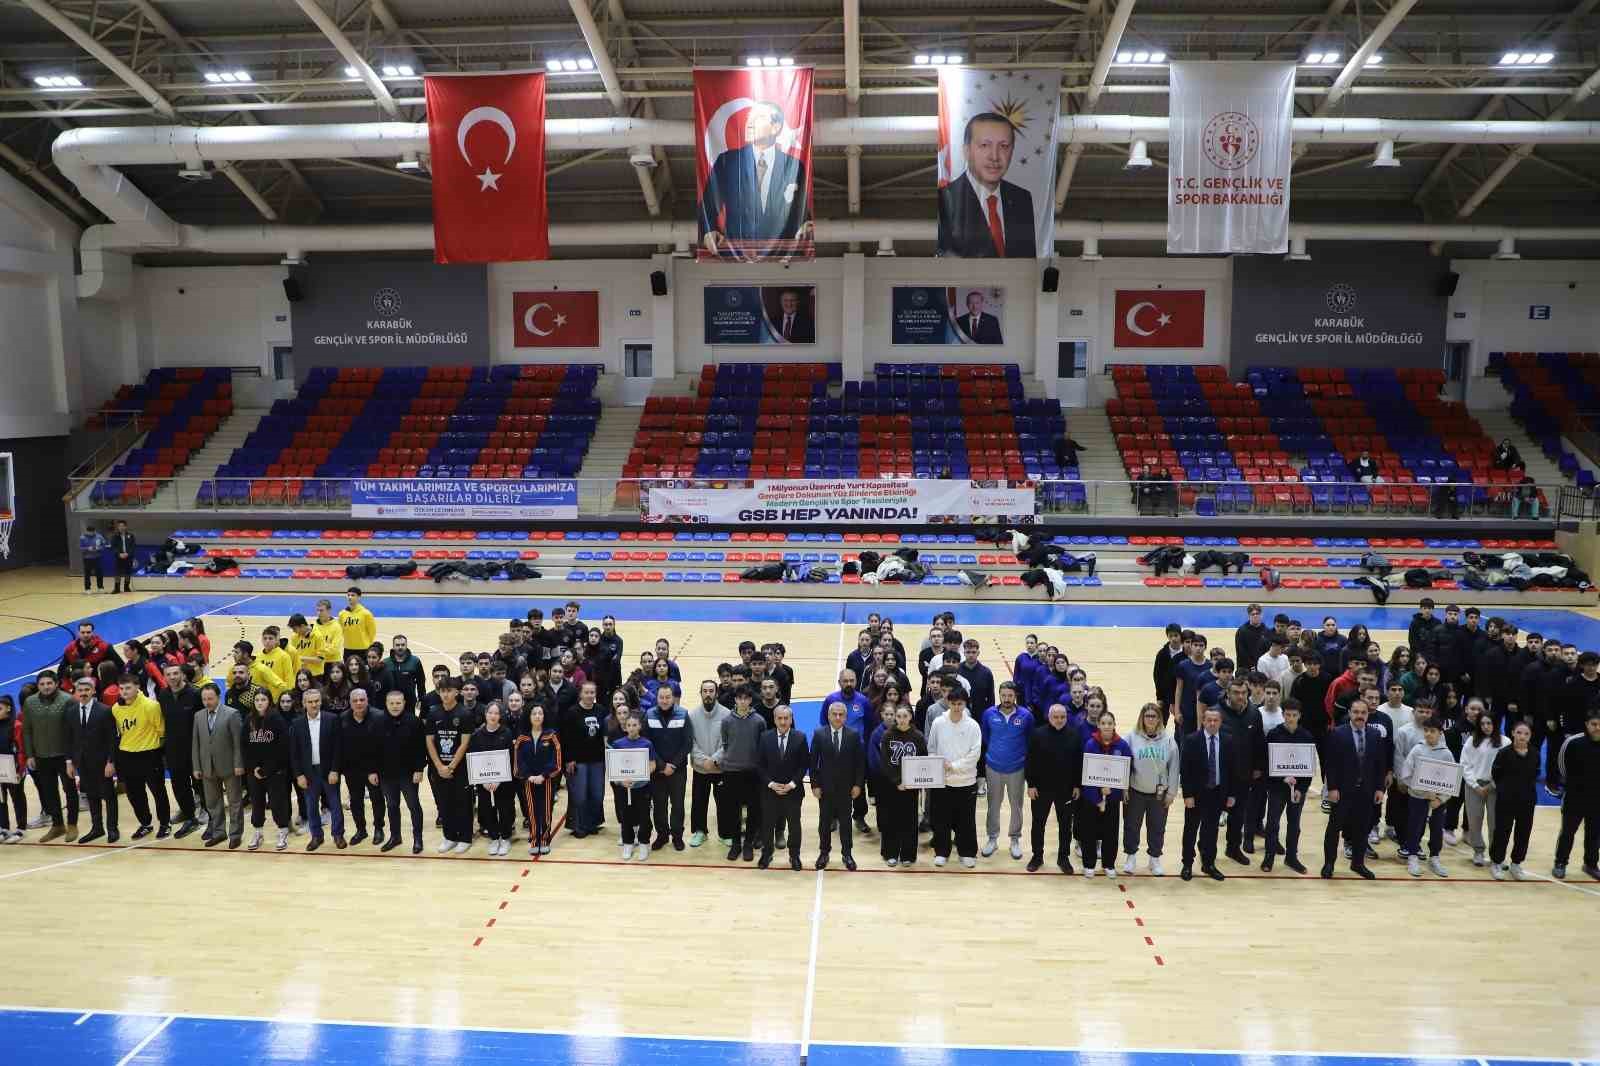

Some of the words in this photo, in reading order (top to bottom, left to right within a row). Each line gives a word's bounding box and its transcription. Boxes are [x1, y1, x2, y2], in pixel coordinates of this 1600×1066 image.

[1175, 177, 1199, 189] T.C.
[1203, 176, 1262, 191] GENÇLİK
[1267, 178, 1284, 189] VE
[1175, 193, 1210, 205] SPOR
[1213, 191, 1283, 205] BAKANLIĞI
[366, 318, 413, 329] KARABÜK
[1314, 316, 1365, 328] KARABÜK
[314, 333, 353, 346] GENÇLİK
[355, 335, 367, 345] VE
[368, 335, 394, 345] SPOR
[395, 333, 404, 344] İL
[406, 332, 468, 344] MÜDÜRLÜĞÜ
[1255, 331, 1298, 345] GENÇLİK
[1301, 333, 1313, 343] VE
[1315, 333, 1342, 343] SPOR
[1344, 331, 1353, 344] İL
[1355, 332, 1423, 344] MÜDÜRLÜĞÜ
[353, 480, 376, 491] TÜM
[378, 481, 460, 492] TAKIMLARIMIZA
[463, 482, 478, 492] VE
[480, 481, 575, 492] SPORCULARIMIZA
[406, 493, 472, 505] BAŞARILAR
[477, 492, 521, 504] DİLERİZ
[738, 508, 778, 521] GSB
[781, 508, 821, 520] HEP
[824, 507, 918, 520] YANINDA!
